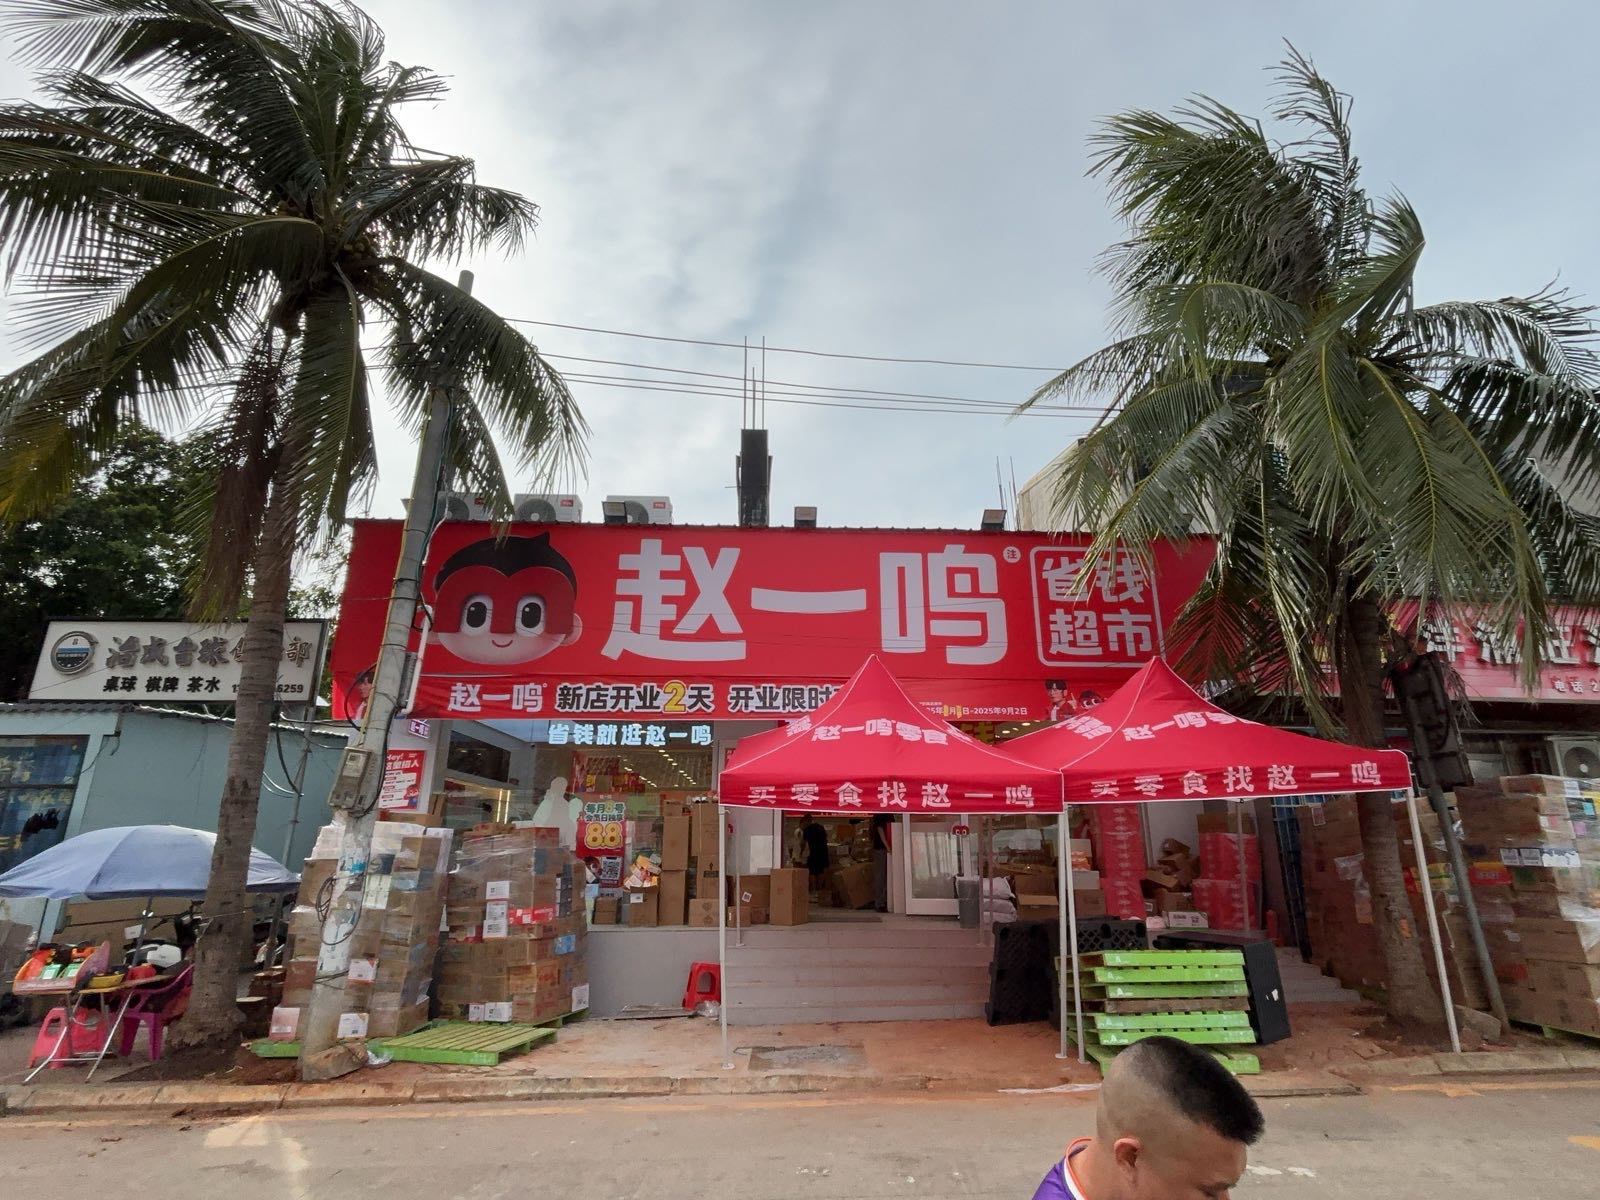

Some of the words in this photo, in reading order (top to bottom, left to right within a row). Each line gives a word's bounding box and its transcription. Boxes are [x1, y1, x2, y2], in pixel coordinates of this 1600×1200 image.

[1042, 557, 1145, 603] 省钱
[601, 538, 1008, 665] 赵一鸣
[1049, 608, 1153, 657] 超市
[103, 676, 136, 692] 桌球
[145, 677, 179, 692] 棋牌
[186, 677, 220, 692] 茶水
[447, 683, 543, 712] 赵一鸣
[556, 681, 714, 712] 新店开业2天
[729, 685, 841, 711] 开业限时
[1554, 679, 1585, 694] 电话
[548, 724, 712, 746] 省钱就逛赵一鸣
[1090, 760, 1382, 798] 买零食找赵一鸣
[748, 781, 1035, 809] 买零食找赵一鸣
